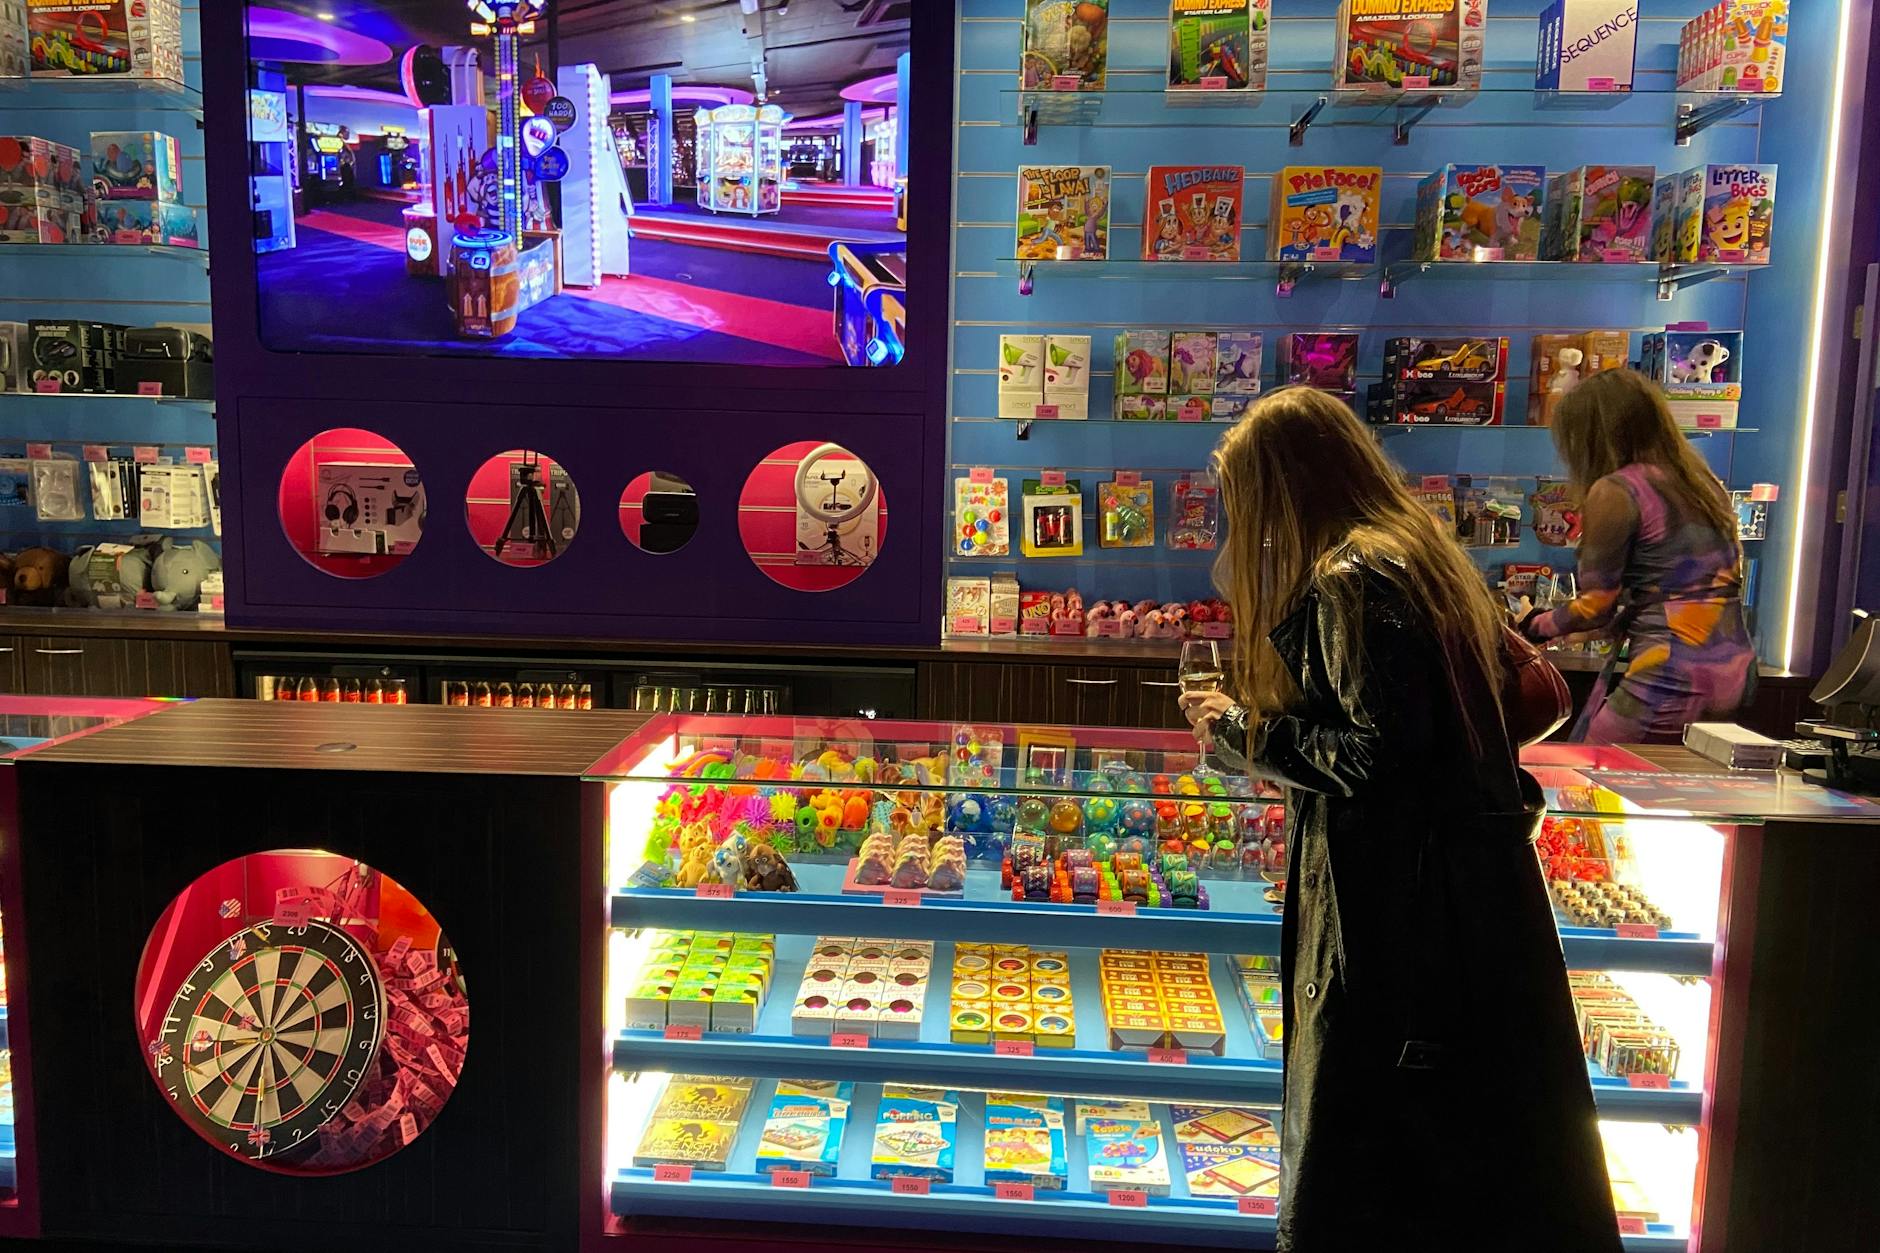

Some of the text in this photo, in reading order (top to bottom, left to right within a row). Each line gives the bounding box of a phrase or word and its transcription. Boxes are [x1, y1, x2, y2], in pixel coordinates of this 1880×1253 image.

[1351, 0, 1455, 15] DOMINO EXPRESS
[1560, 7, 1638, 64] SEQUENCE
[551, 102, 569, 110] TOO
[1023, 167, 1081, 186] THE FLOOR
[1164, 167, 1239, 195] HEDBANZ
[1713, 169, 1761, 186] LITTER
[1050, 177, 1091, 199] LAVA!
[1730, 184, 1768, 197] BUGS
[551, 469, 568, 477] TRIPO
[1023, 600, 1051, 618] UNO
[287, 925, 308, 937] 20
[341, 944, 358, 963] 18
[443, 948, 450, 957] 11
[203, 958, 214, 972] 9
[176, 982, 196, 1001] 14
[364, 1001, 378, 1021] 13
[841, 1038, 855, 1046] 325
[1160, 1055, 1173, 1063] 400
[343, 1069, 361, 1090] 10
[320, 1100, 339, 1119] 15
[696, 1104, 733, 1113] NIGHT
[680, 1142, 720, 1151] NIGHT
[782, 1177, 798, 1185] 1550
[902, 1184, 919, 1192] 1550
[1006, 1190, 1023, 1198] 1550
[1118, 1194, 1136, 1202] 1200
[1247, 1202, 1265, 1210] 1350
